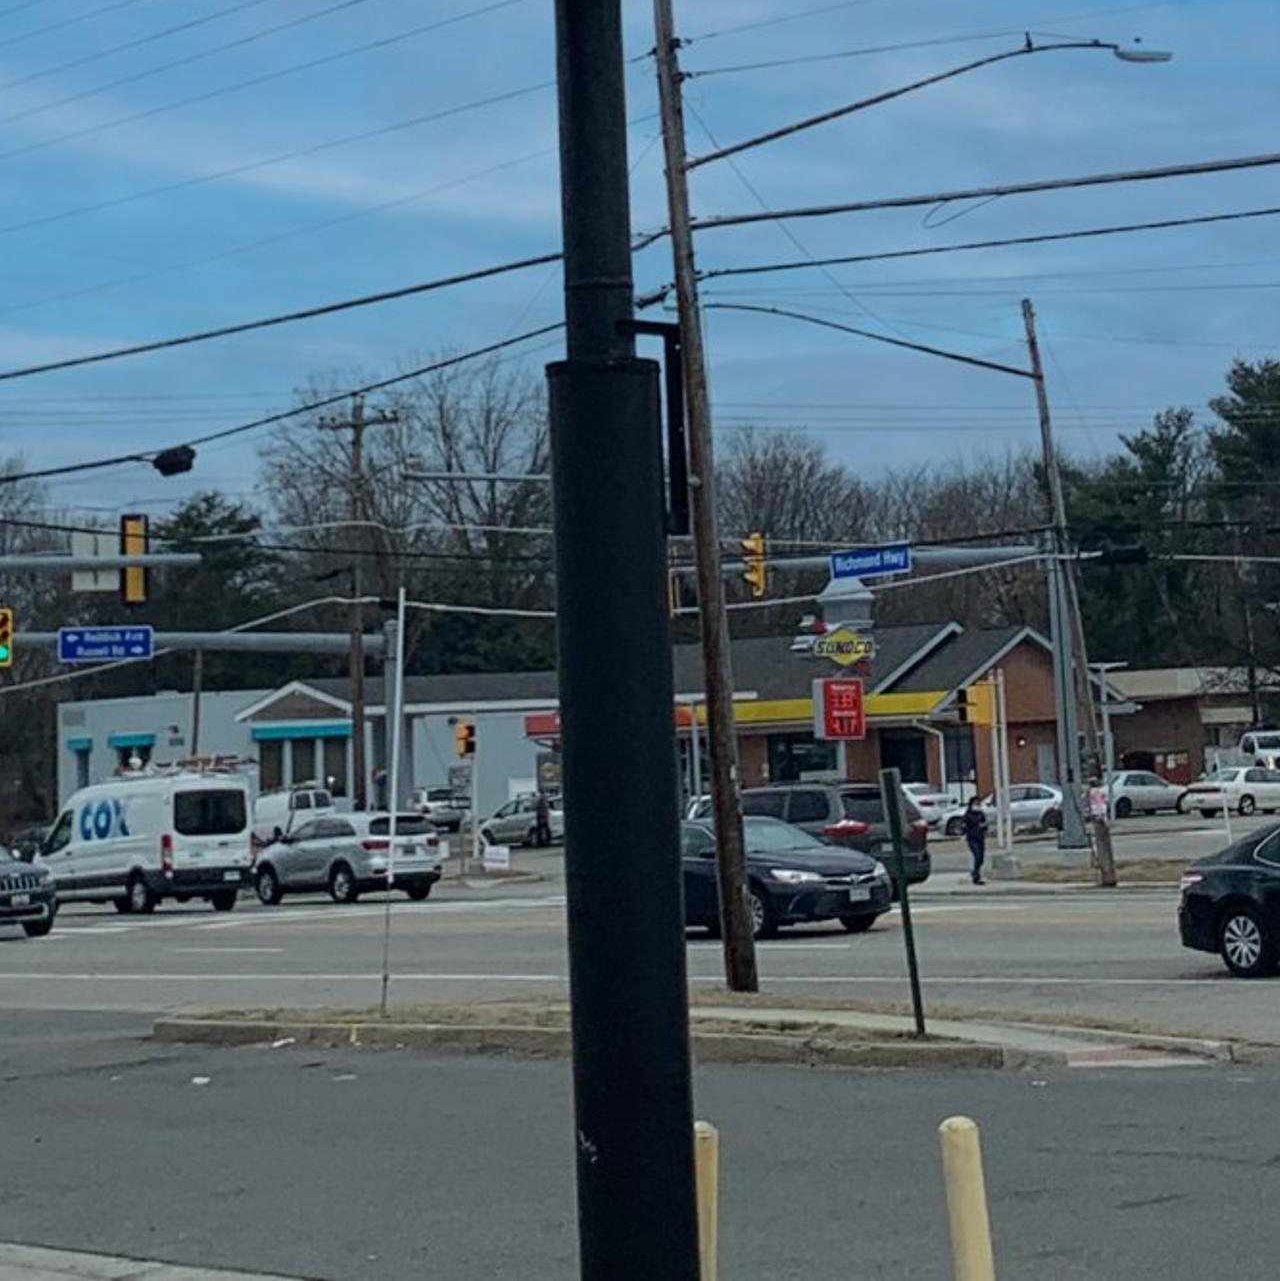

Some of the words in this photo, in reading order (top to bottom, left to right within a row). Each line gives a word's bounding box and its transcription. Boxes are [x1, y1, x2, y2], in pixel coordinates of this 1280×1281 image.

[835, 552, 880, 571] Richmond
[882, 548, 906, 568] Hwy
[815, 640, 873, 654] SUNOCO
[80, 799, 130, 841] COX
